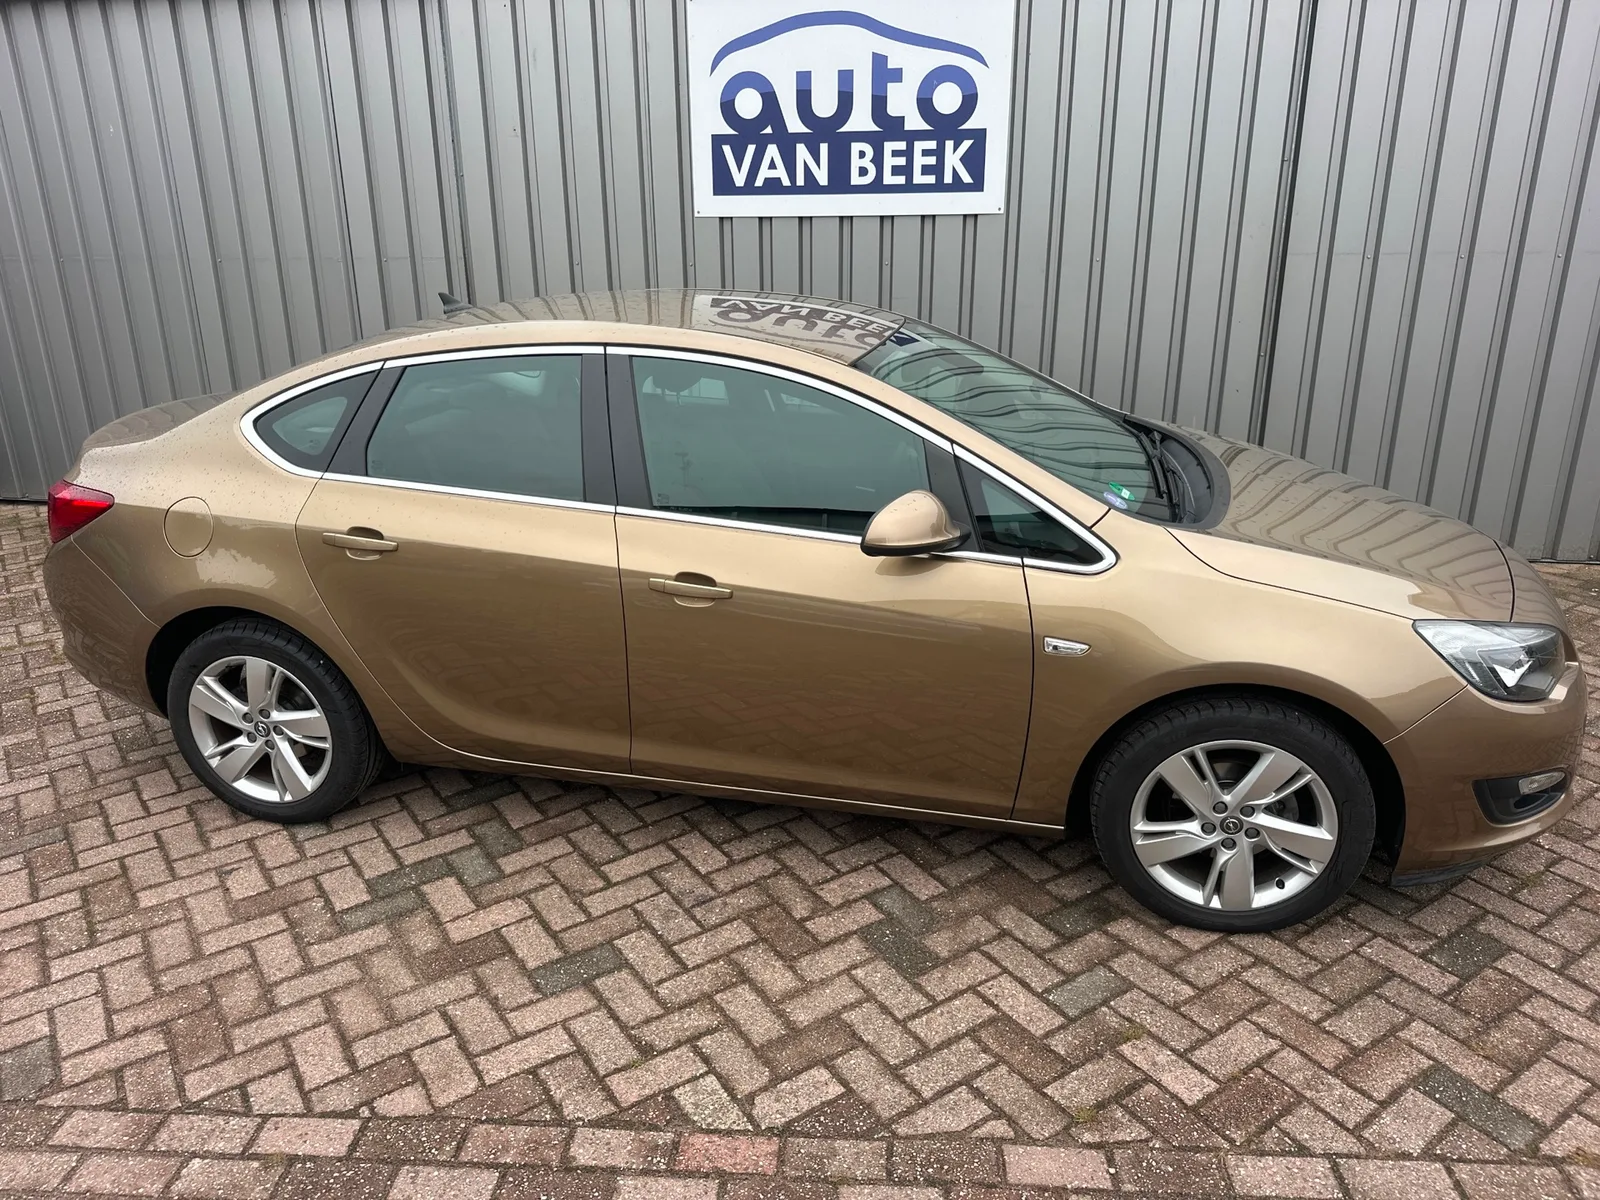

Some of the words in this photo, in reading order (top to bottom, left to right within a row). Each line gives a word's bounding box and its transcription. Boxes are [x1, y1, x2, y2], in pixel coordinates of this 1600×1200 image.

[720, 51, 978, 134] auto
[721, 142, 829, 188] VAN
[849, 139, 975, 186] BEEK
